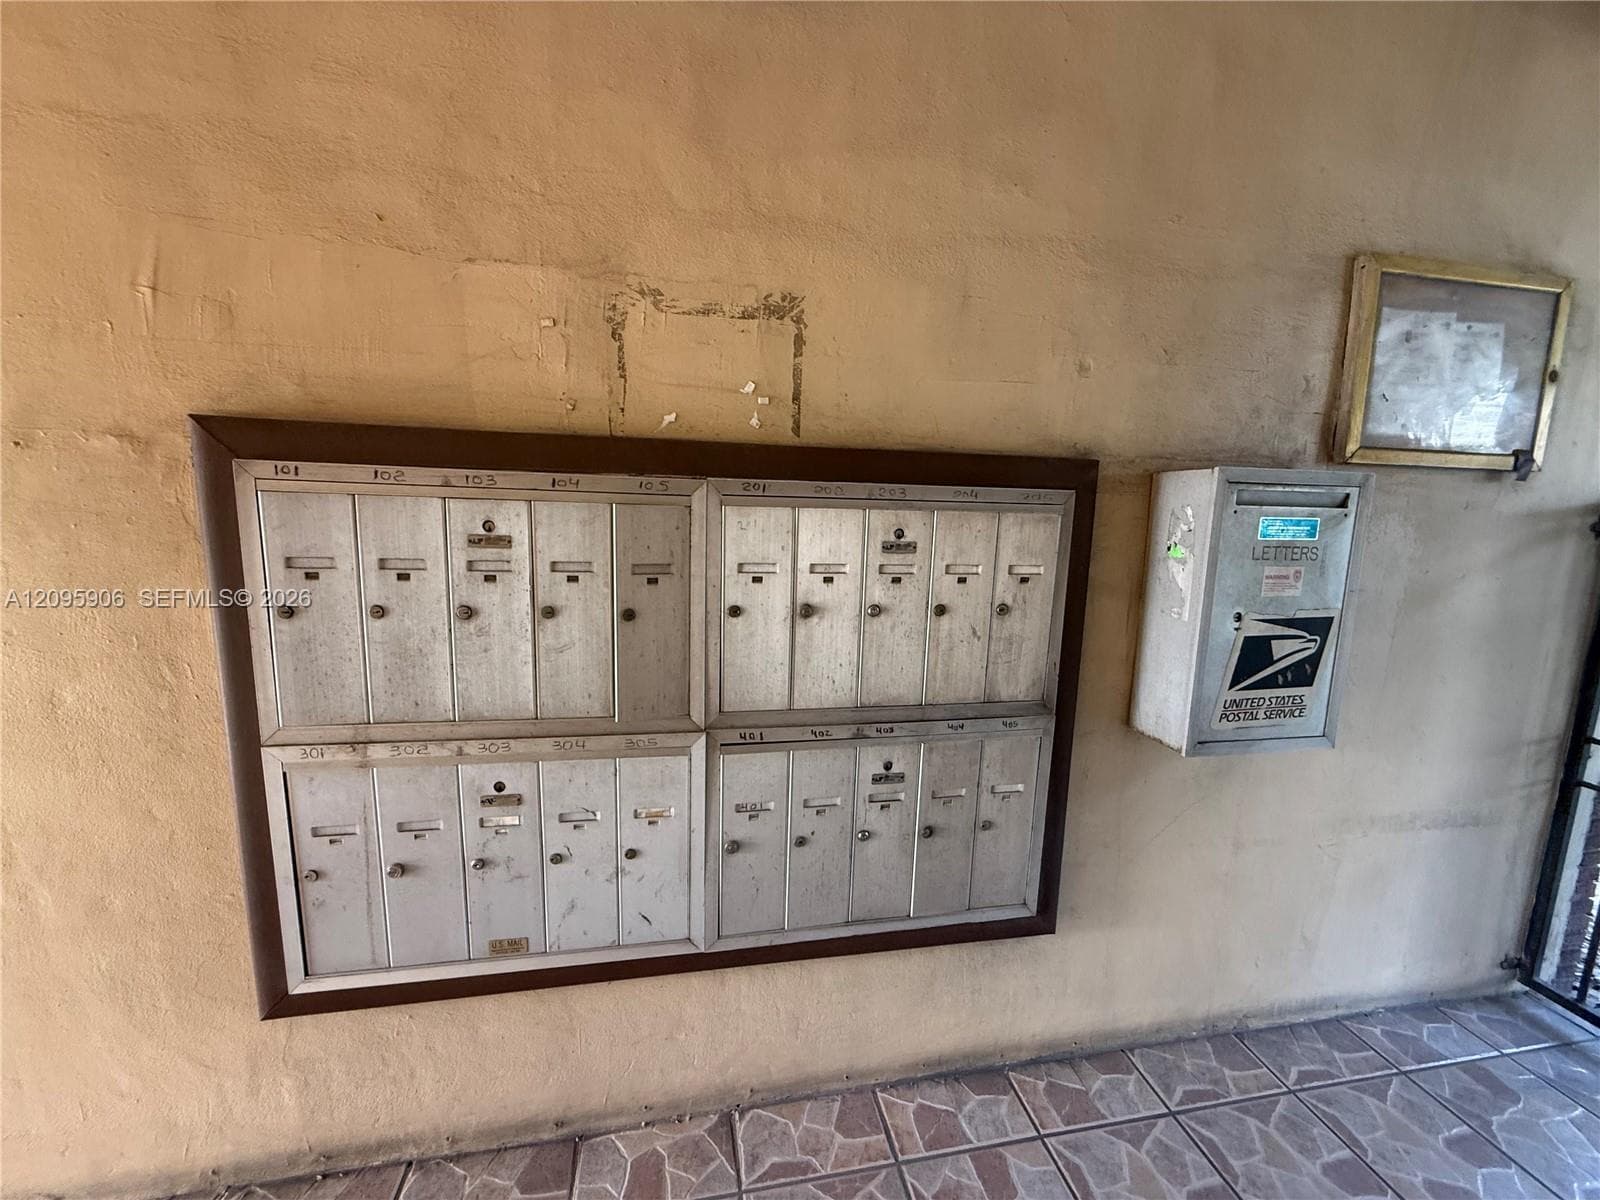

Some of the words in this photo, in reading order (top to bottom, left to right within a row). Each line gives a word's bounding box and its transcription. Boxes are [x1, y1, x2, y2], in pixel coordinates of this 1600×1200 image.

[274, 463, 299, 477] 101
[373, 467, 406, 482] 102
[465, 474, 498, 486] 103
[551, 477, 580, 489] 104
[639, 480, 669, 492] 105
[741, 482, 767, 494] 201
[878, 487, 907, 498] 203
[1251, 545, 1319, 562] LETTERS
[1222, 696, 1266, 710] UNITED
[1267, 694, 1305, 707] STATES
[1218, 709, 1260, 723] POSTAL
[1263, 707, 1307, 720] SERVICE
[739, 732, 764, 741] 401
[810, 729, 833, 738] 402
[875, 726, 895, 735] 403
[1001, 719, 1019, 729] 405
[300, 747, 324, 760] 301
[389, 744, 431, 758] 302
[477, 742, 512, 754] 303
[551, 739, 587, 751] 304
[623, 738, 659, 748] 305
[740, 802, 764, 812] 401
